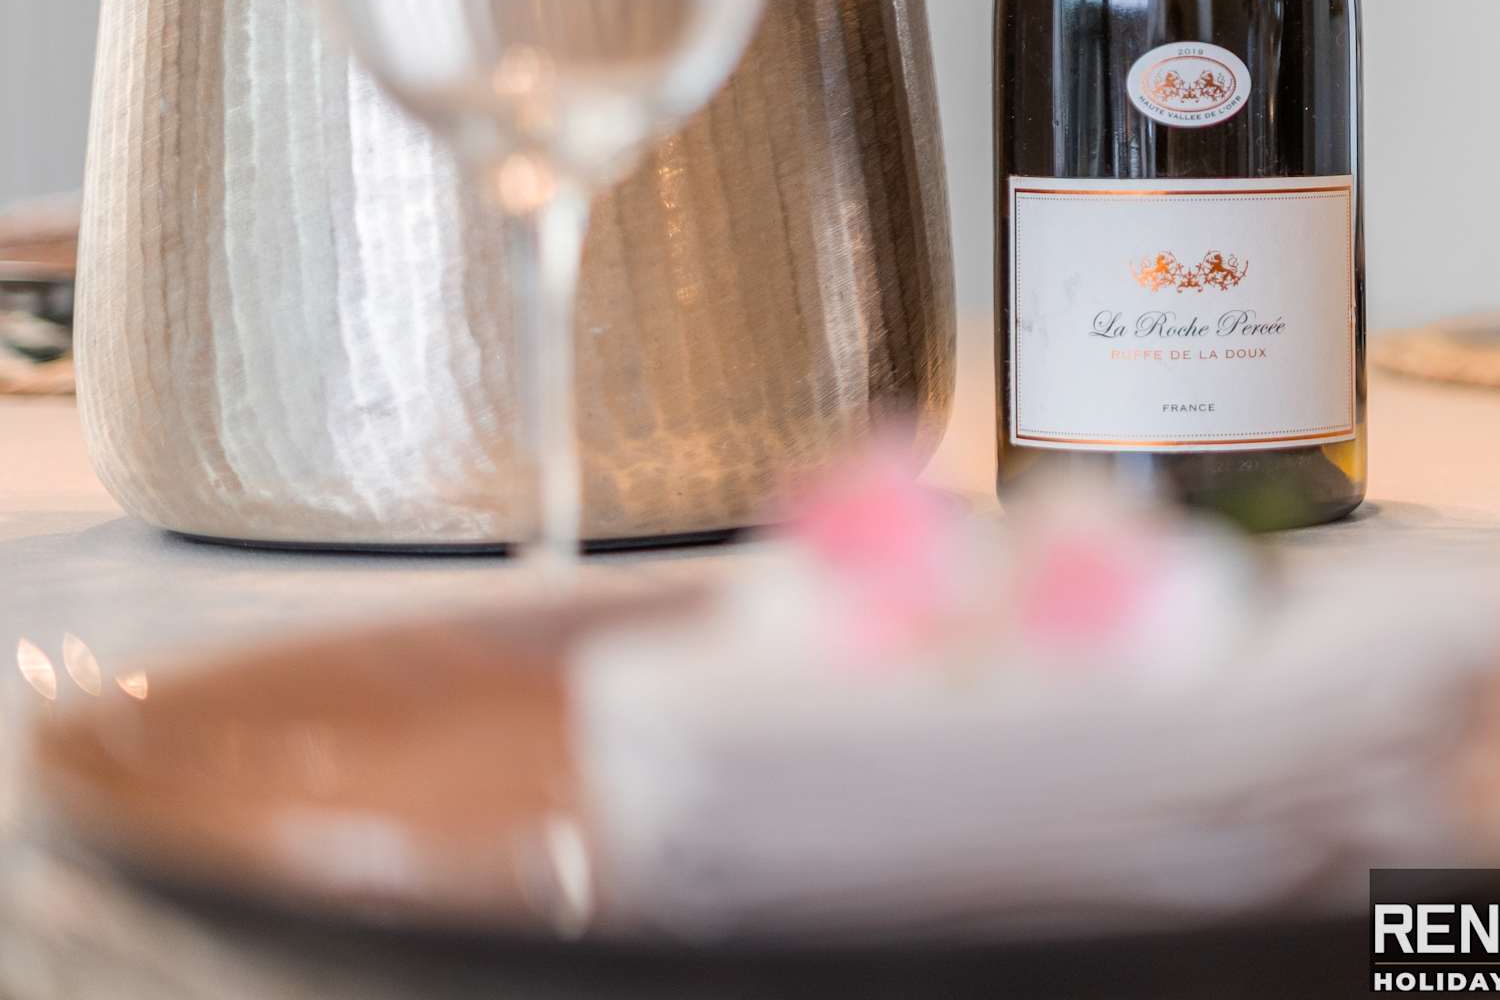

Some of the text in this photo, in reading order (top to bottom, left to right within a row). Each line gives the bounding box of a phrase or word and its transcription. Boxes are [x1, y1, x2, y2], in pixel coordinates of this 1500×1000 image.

[1139, 95, 1165, 115] HAUTE
[1204, 112, 1217, 120] DE
[1088, 309, 1286, 339] La Roche Percée
[1170, 350, 1192, 361] DE
[1199, 350, 1219, 360] LA
[1225, 347, 1268, 359] DOUX
[1162, 403, 1216, 413] FRANCE
